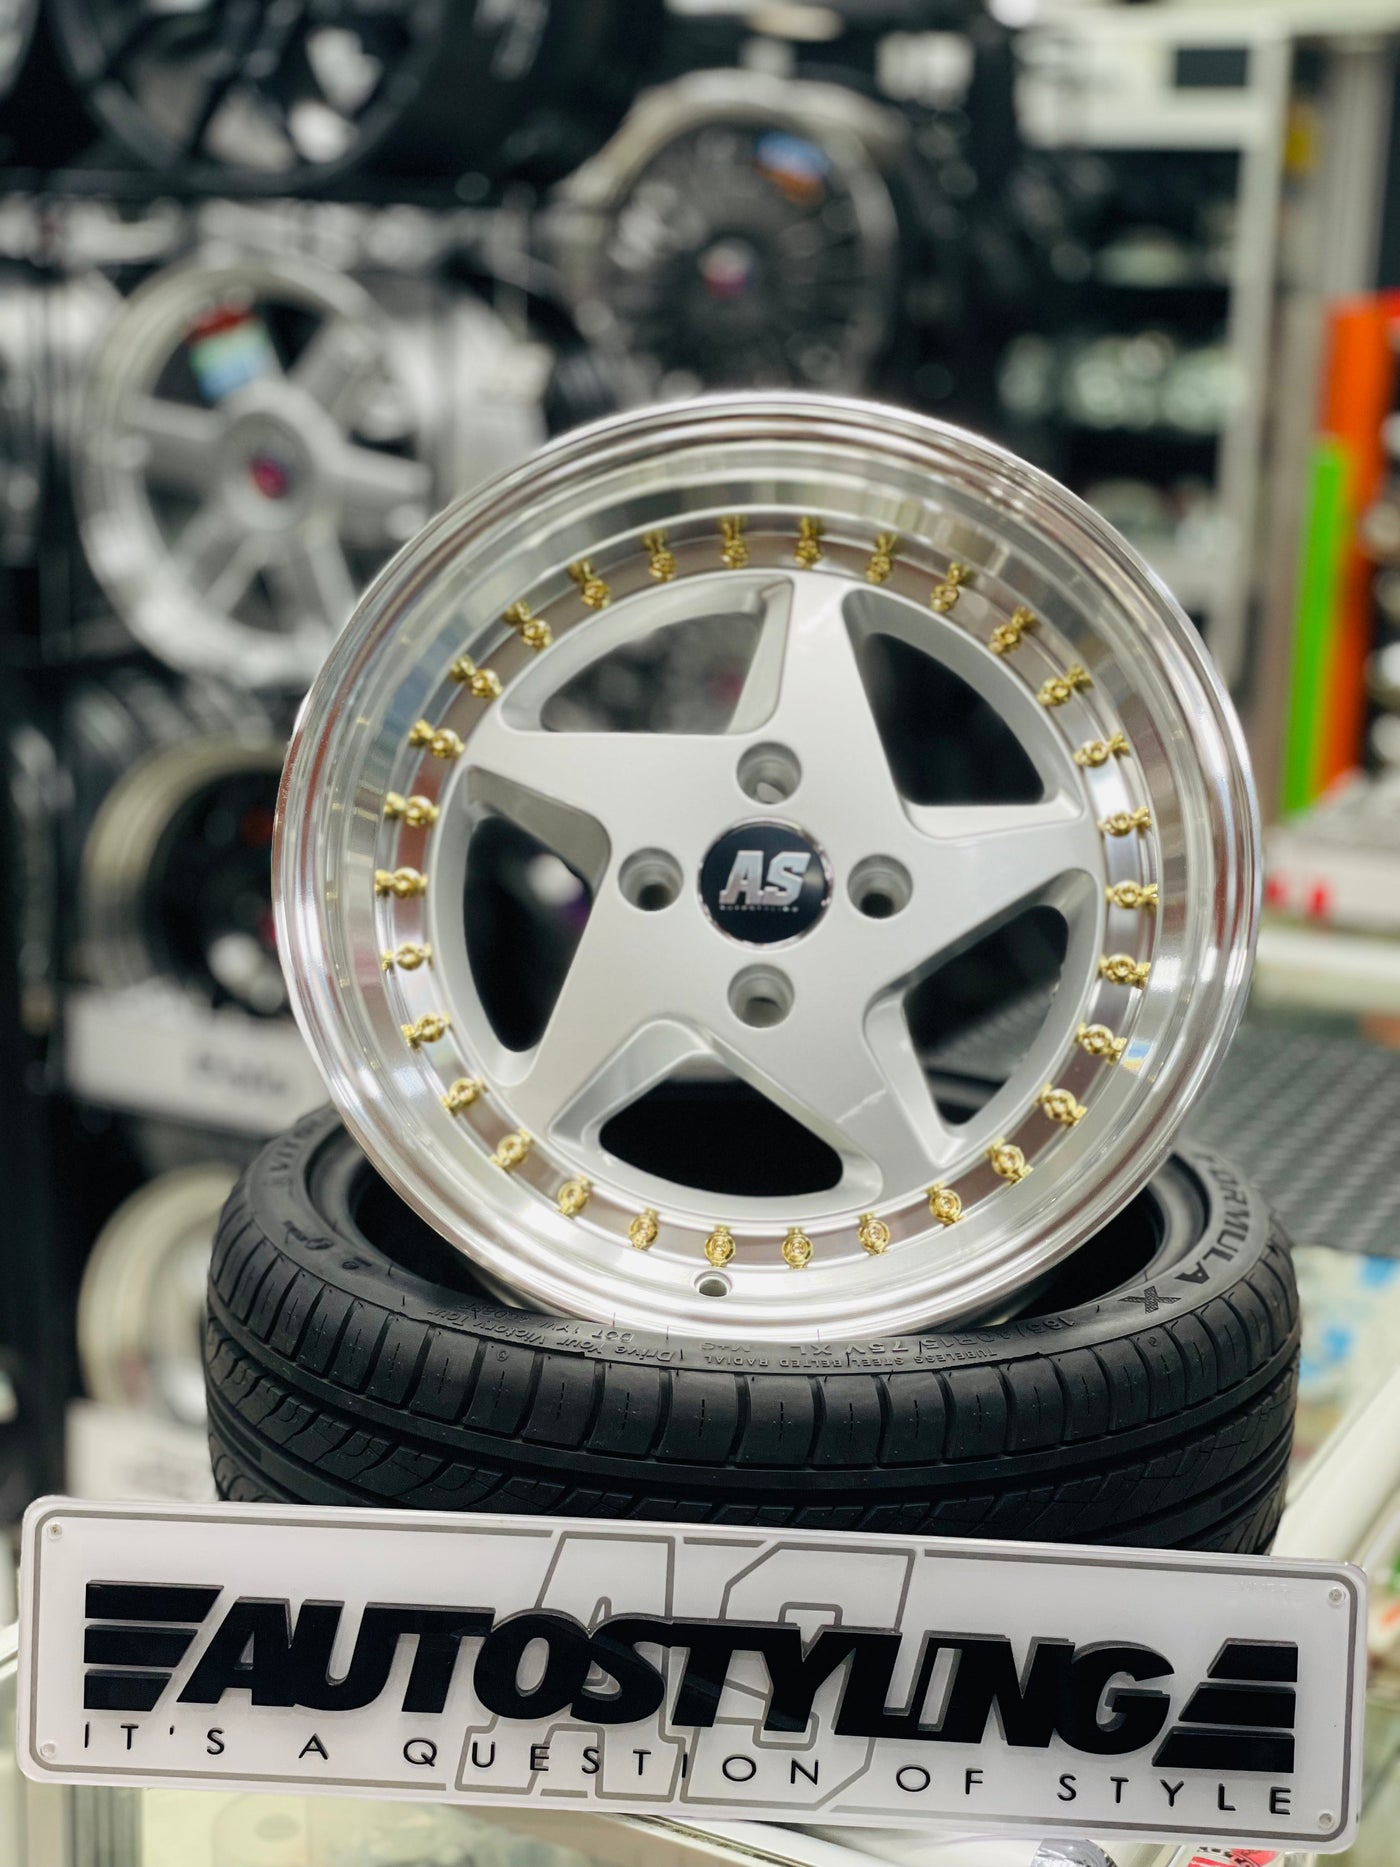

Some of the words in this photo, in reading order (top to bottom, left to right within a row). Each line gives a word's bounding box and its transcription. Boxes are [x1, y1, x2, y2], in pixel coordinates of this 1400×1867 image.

[719, 850, 811, 906] AS
[1174, 1151, 1250, 1285] FORMULA
[426, 1308, 470, 1327] Tour
[472, 1320, 546, 1345] Victory
[614, 1346, 678, 1362] Drive
[704, 1354, 769, 1368] RADIAL
[779, 1358, 843, 1369] BELTED
[852, 1356, 905, 1368] STEEL
[913, 1348, 998, 1364] TUBELESS
[175, 1596, 1176, 1757] AUTOSTYLING
[83, 1722, 226, 1757] IT'S
[298, 1735, 330, 1762] A
[402, 1739, 820, 1787] QUESTION
[895, 1764, 985, 1796] OF
[1056, 1773, 1293, 1816] STYLE
